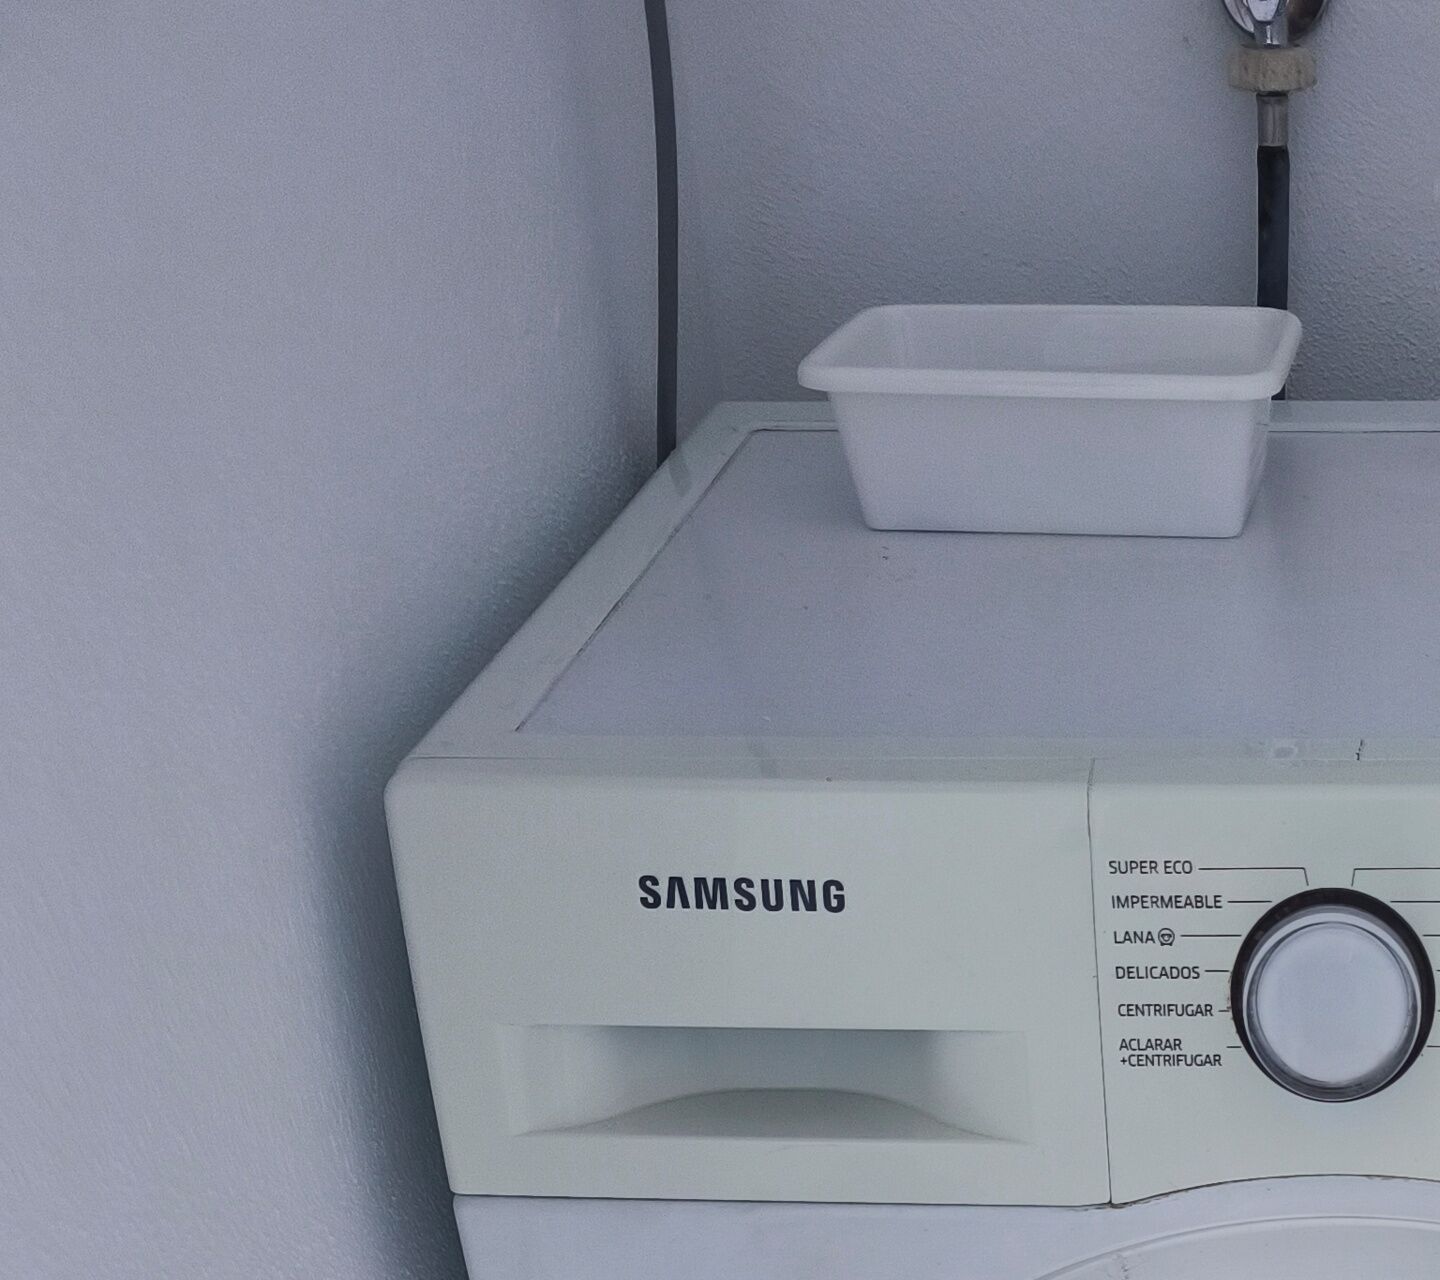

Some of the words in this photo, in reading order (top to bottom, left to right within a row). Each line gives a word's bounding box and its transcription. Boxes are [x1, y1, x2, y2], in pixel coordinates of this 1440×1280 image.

[1108, 860, 1159, 875] SUPER
[1162, 860, 1193, 875] ECO
[638, 875, 846, 913] SAMSUNG
[1111, 895, 1223, 909] IMPERMEABLE
[1113, 930, 1155, 945] LANA
[1115, 966, 1200, 980] DELICADOS
[1117, 1003, 1213, 1018] CENTRIFUGAR
[1119, 1038, 1182, 1052] ACLARAR
[1120, 1054, 1222, 1068] +CENTRIFUGAR
